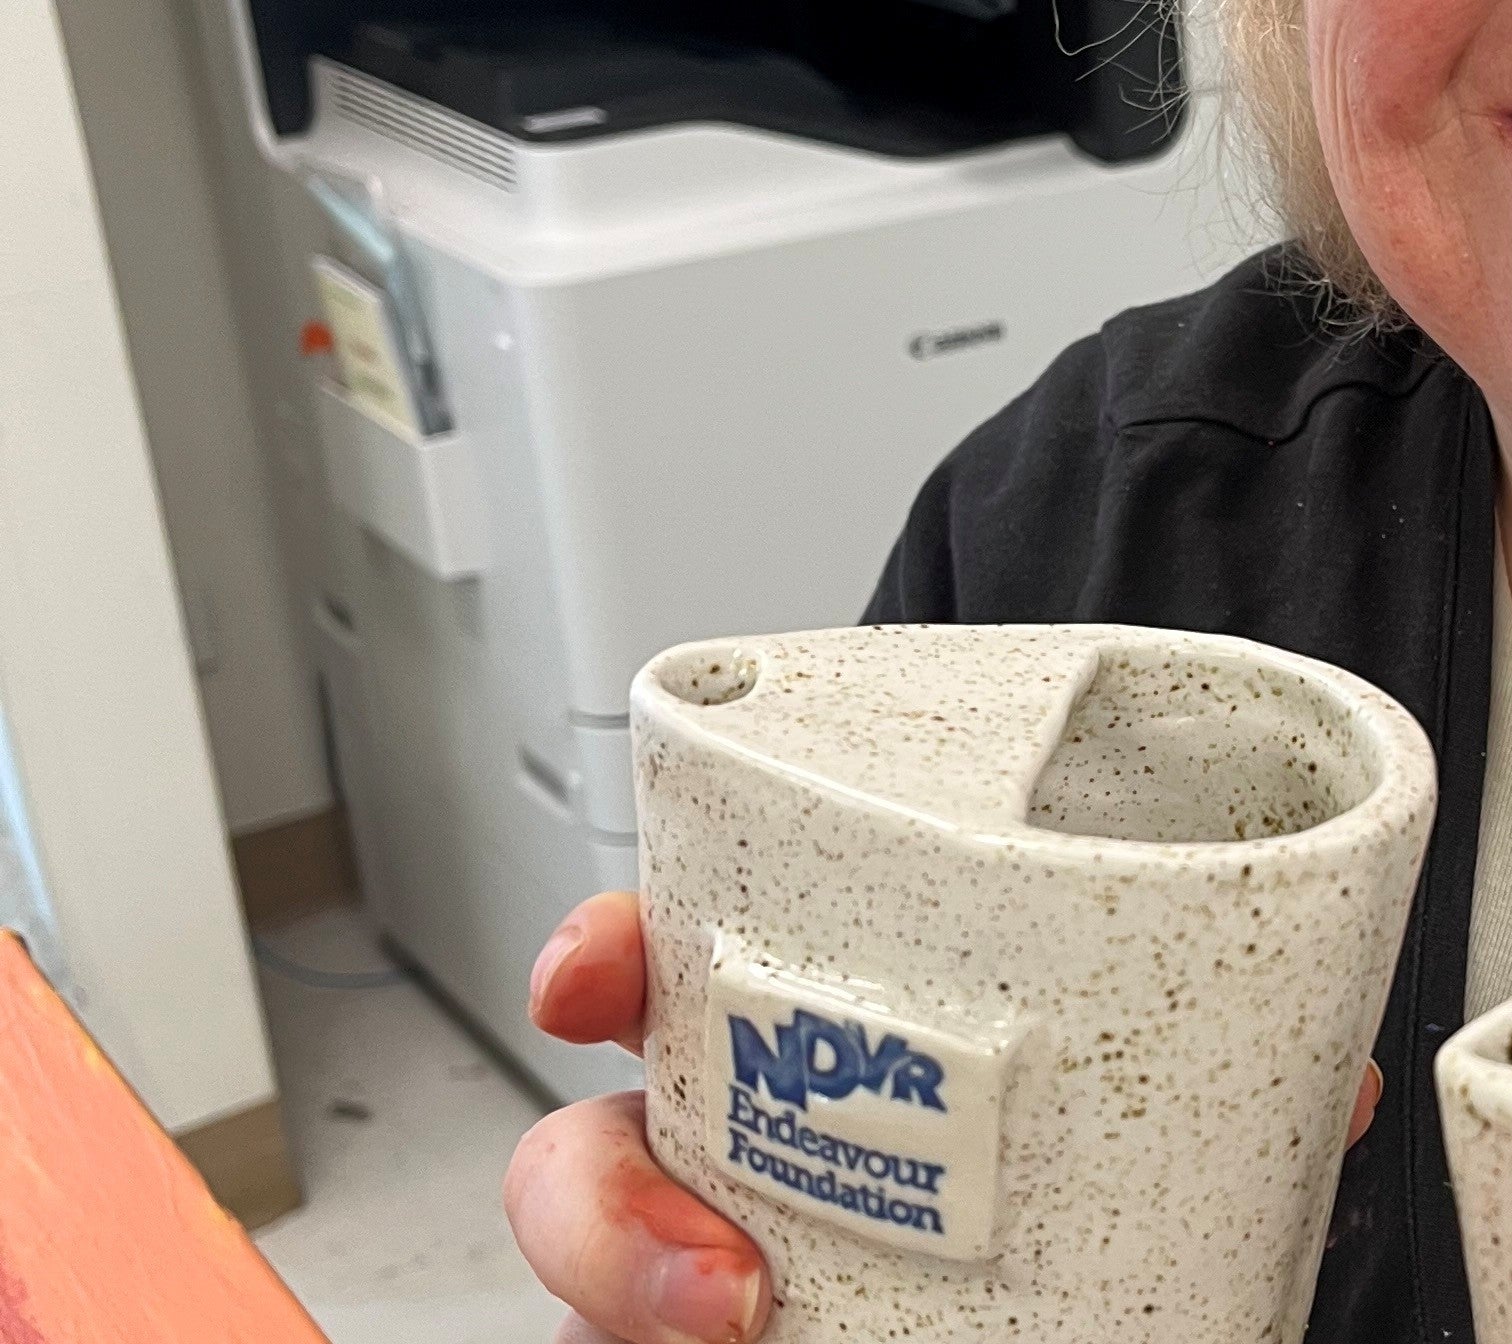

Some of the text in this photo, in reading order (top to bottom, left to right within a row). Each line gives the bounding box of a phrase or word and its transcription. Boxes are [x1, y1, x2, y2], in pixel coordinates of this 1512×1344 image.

[728, 1008, 949, 1113] NDVR
[727, 1084, 947, 1196] Endeavour
[727, 1127, 946, 1236] Foundation
